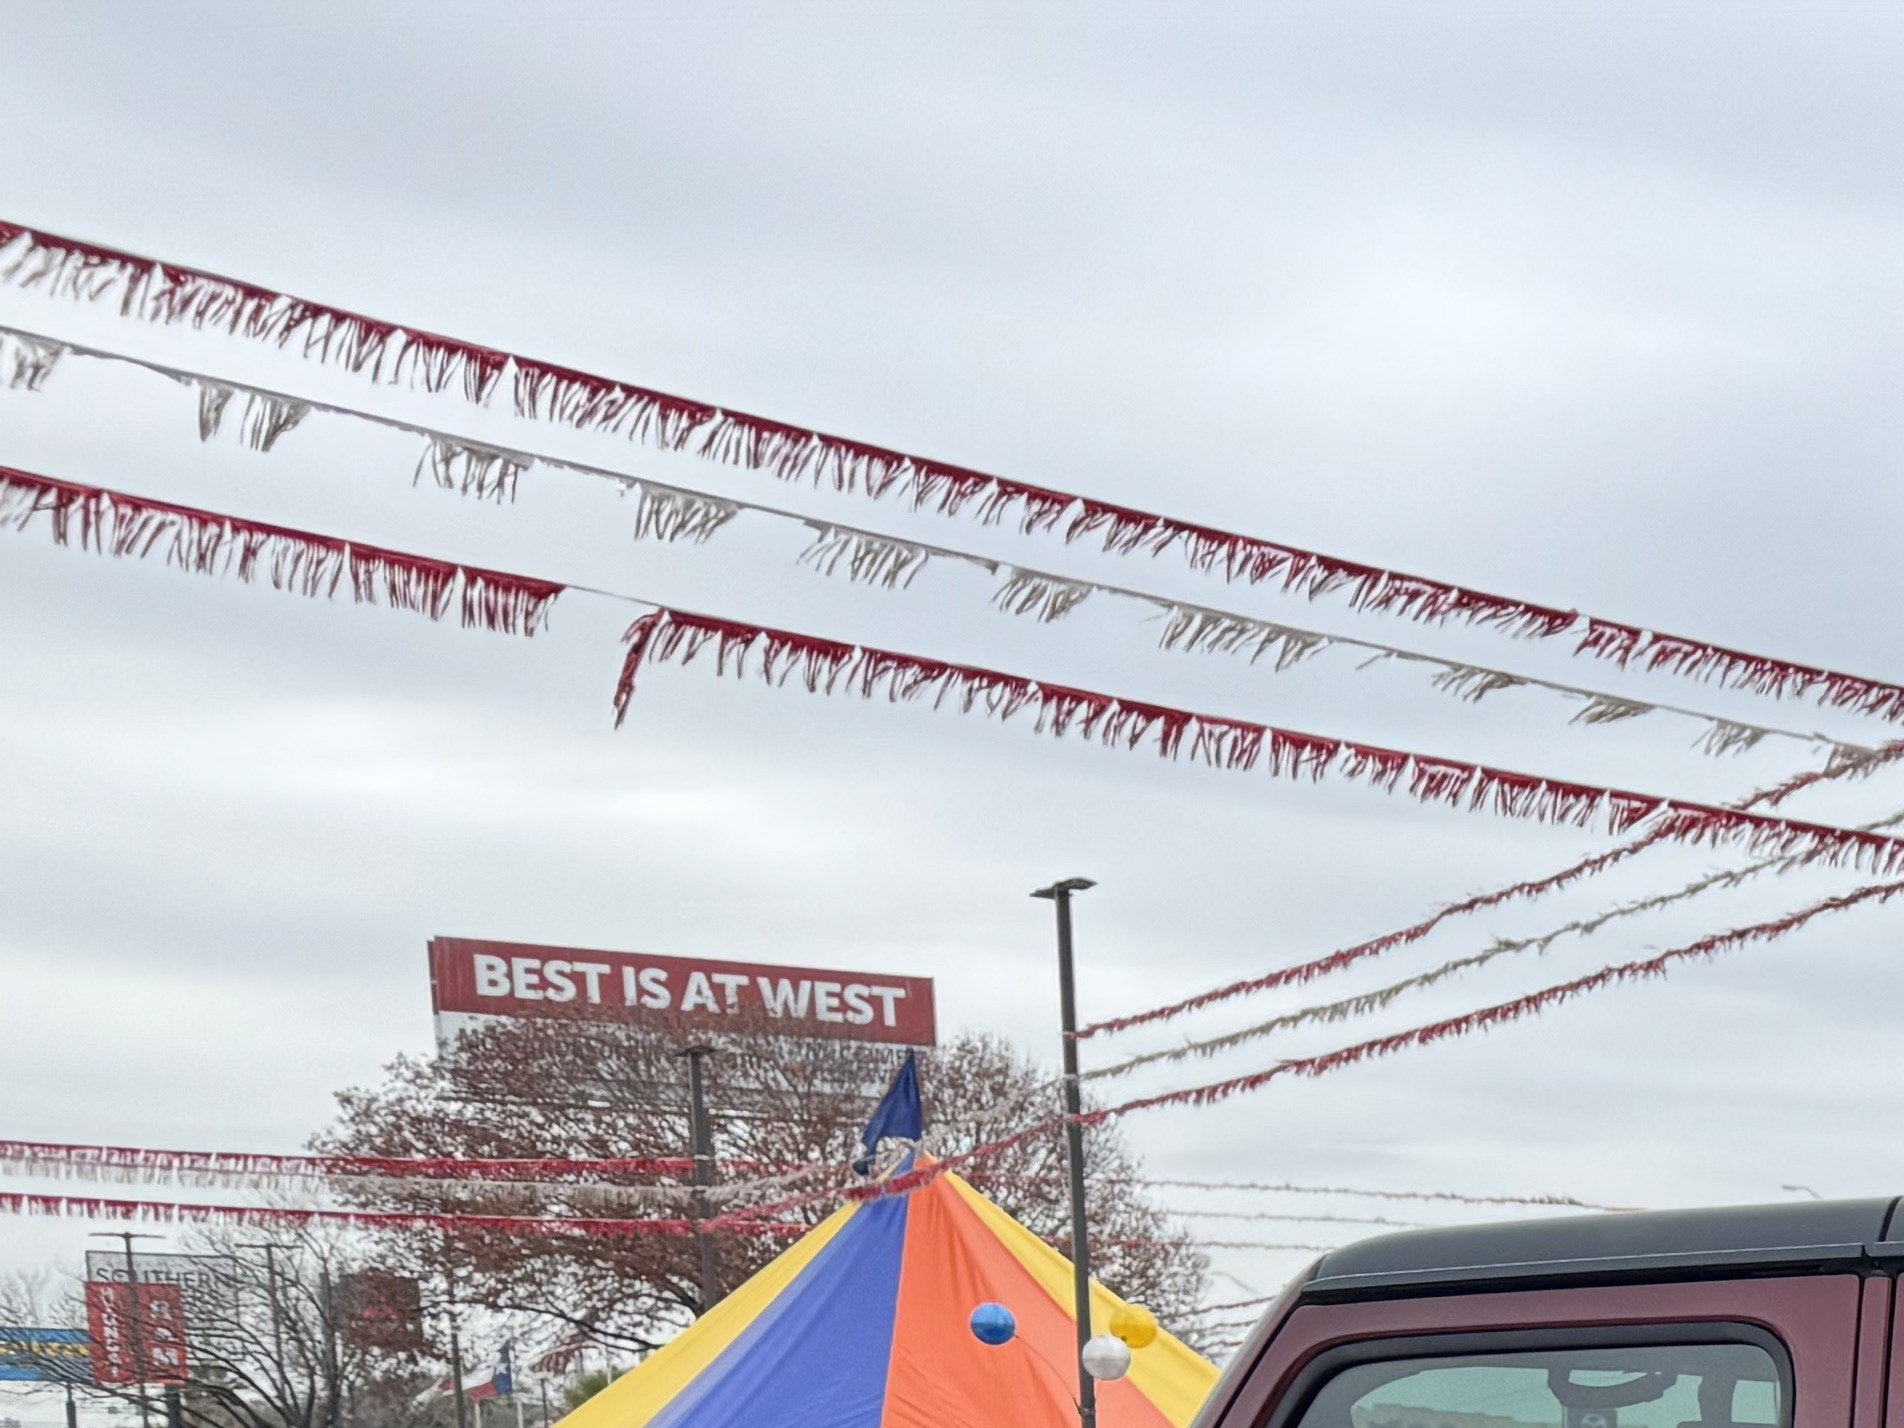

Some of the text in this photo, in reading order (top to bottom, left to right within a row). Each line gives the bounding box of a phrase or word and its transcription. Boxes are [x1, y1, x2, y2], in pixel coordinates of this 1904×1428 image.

[473, 953, 906, 1028] BEST IS AT WEST
